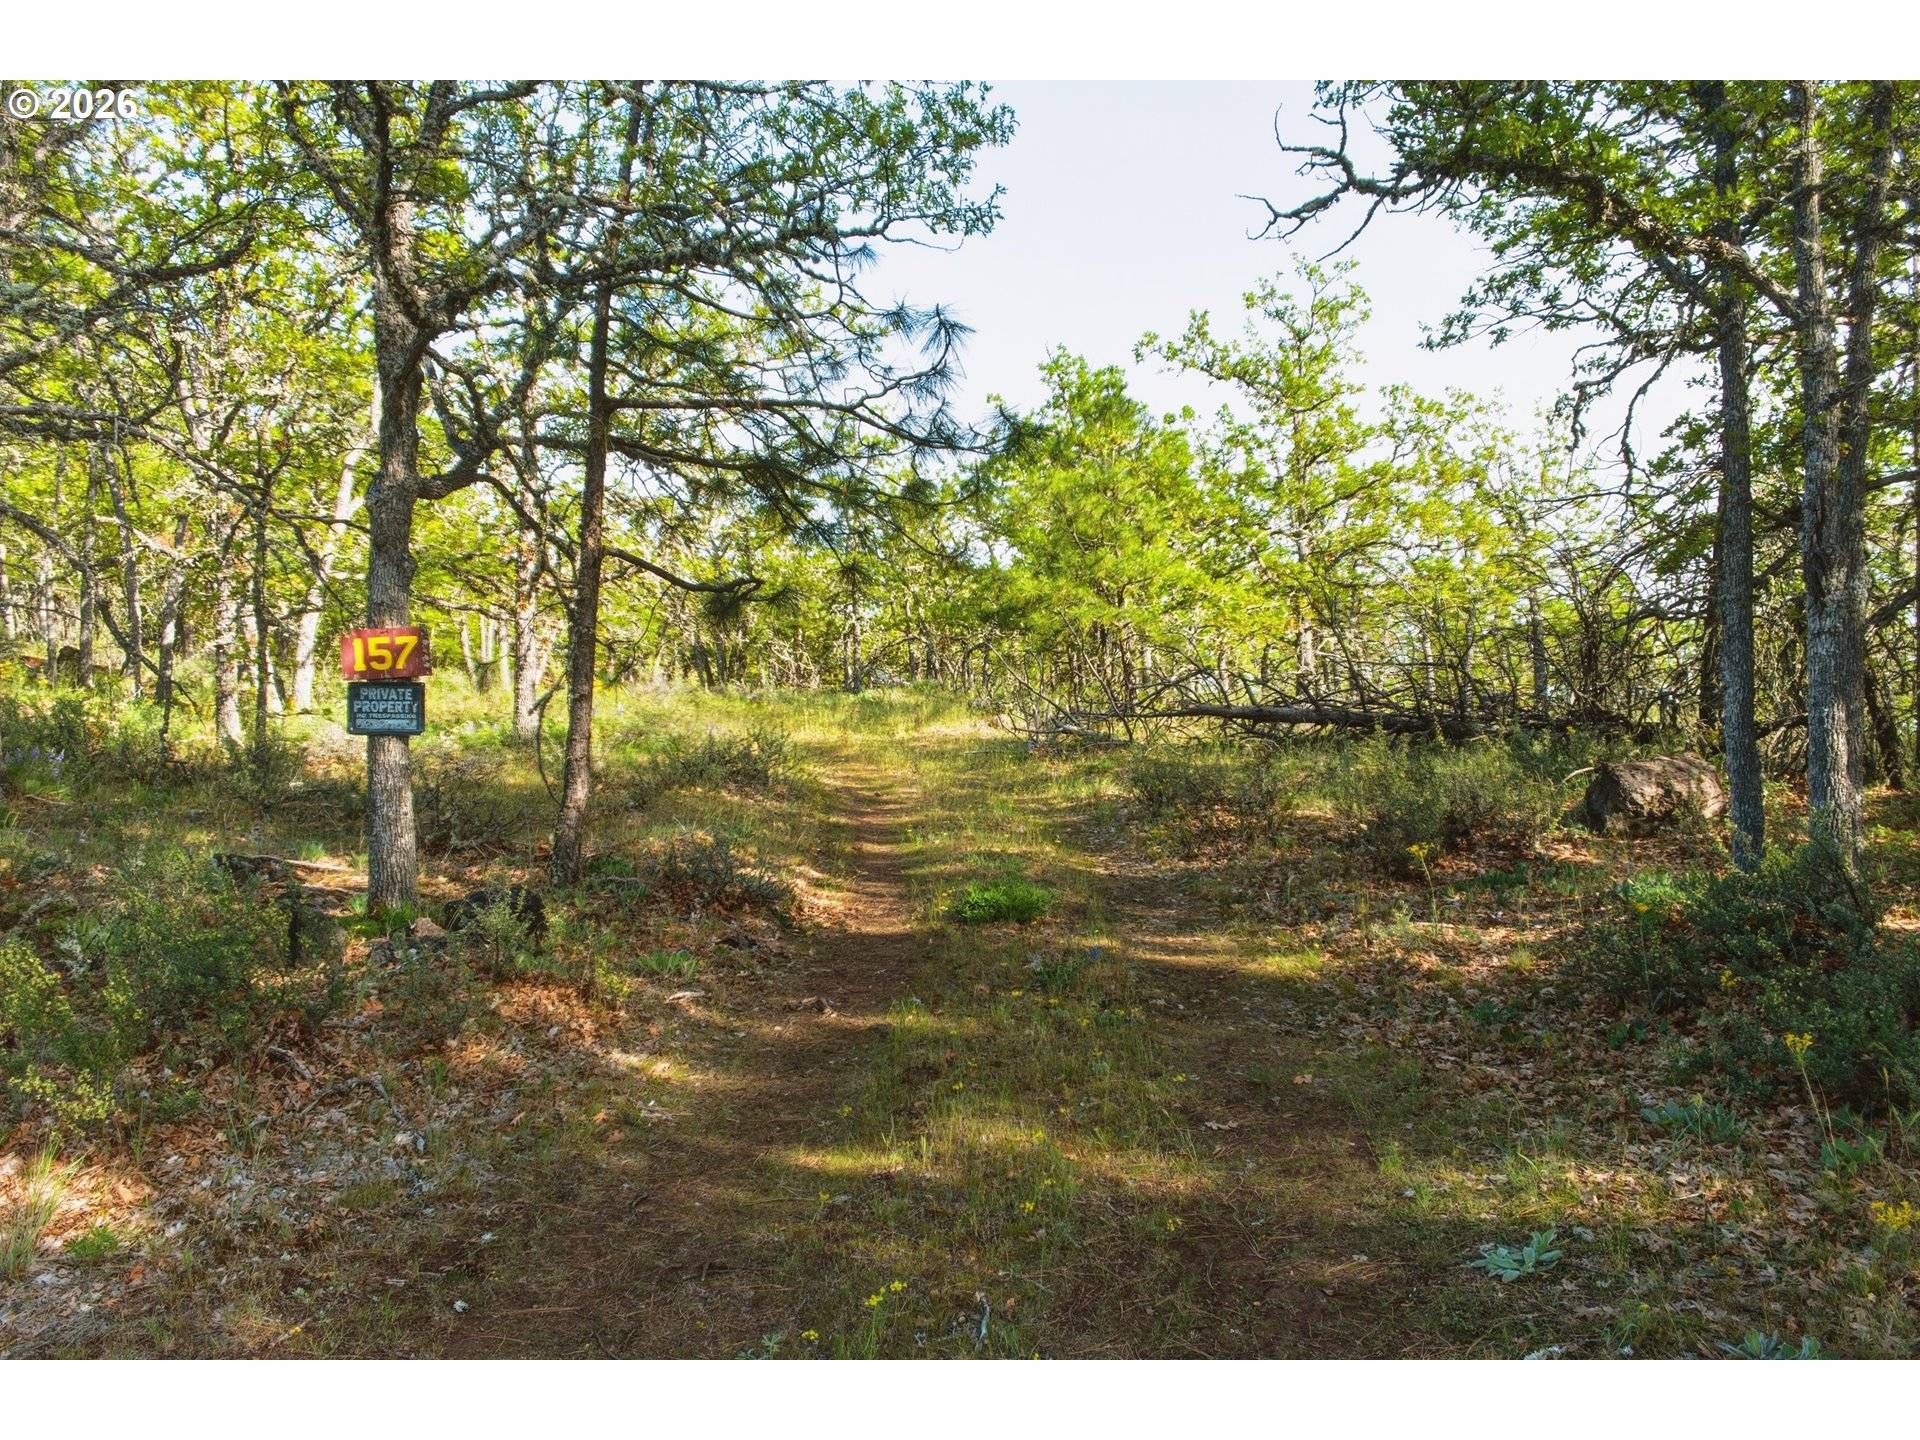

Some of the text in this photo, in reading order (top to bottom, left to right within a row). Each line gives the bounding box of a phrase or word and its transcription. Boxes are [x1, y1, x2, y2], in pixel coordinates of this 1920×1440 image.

[352, 635, 418, 672] 157
[360, 687, 413, 700] PRIVATE
[353, 700, 418, 713] PROPERTY
